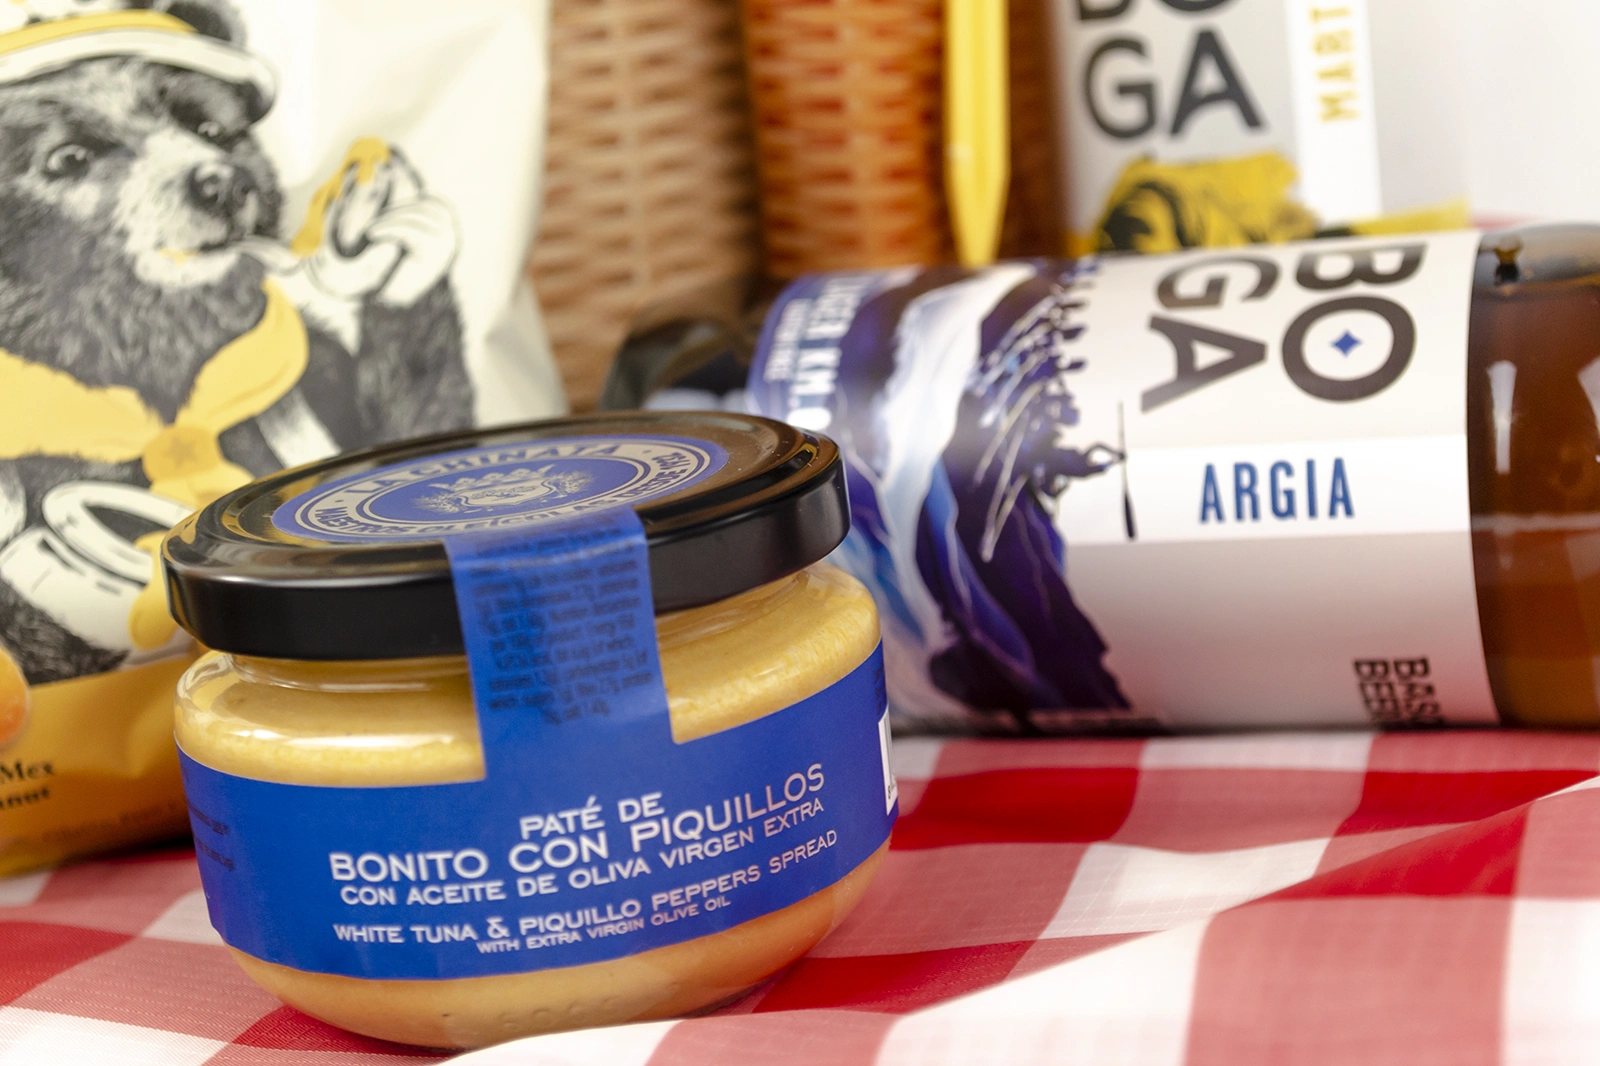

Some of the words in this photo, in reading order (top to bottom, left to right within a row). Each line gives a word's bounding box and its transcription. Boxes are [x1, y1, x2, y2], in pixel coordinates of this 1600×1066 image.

[1083, 25, 1268, 141] GA
[1139, 251, 1282, 415] GA
[1279, 240, 1428, 404] BO
[408, 444, 622, 477] CHINATA
[1200, 457, 1356, 524] ARGIA
[329, 848, 489, 883] BONITO
[508, 830, 609, 875] CON
[629, 763, 825, 853] PIQUILLOS
[340, 885, 396, 906] CON
[406, 880, 507, 906] ACEITE
[516, 873, 559, 897] DE
[568, 857, 652, 889] OLIVA
[658, 825, 755, 869] VIRGEN
[763, 797, 825, 837] EXTRA
[520, 796, 606, 840] PATÉ
[618, 791, 665, 823] DE
[333, 924, 405, 944] WHITE
[410, 924, 478, 944] TUNA
[486, 916, 510, 939] &
[518, 899, 642, 935] PIQUILLO
[650, 864, 762, 912] PEPPERS
[769, 829, 838, 874] SPREAD
[476, 939, 520, 954] WITH
[526, 931, 582, 950] EXTRA
[588, 918, 645, 939] VIRGIN
[650, 903, 699, 926] OLIVE
[705, 896, 732, 912] OIL
